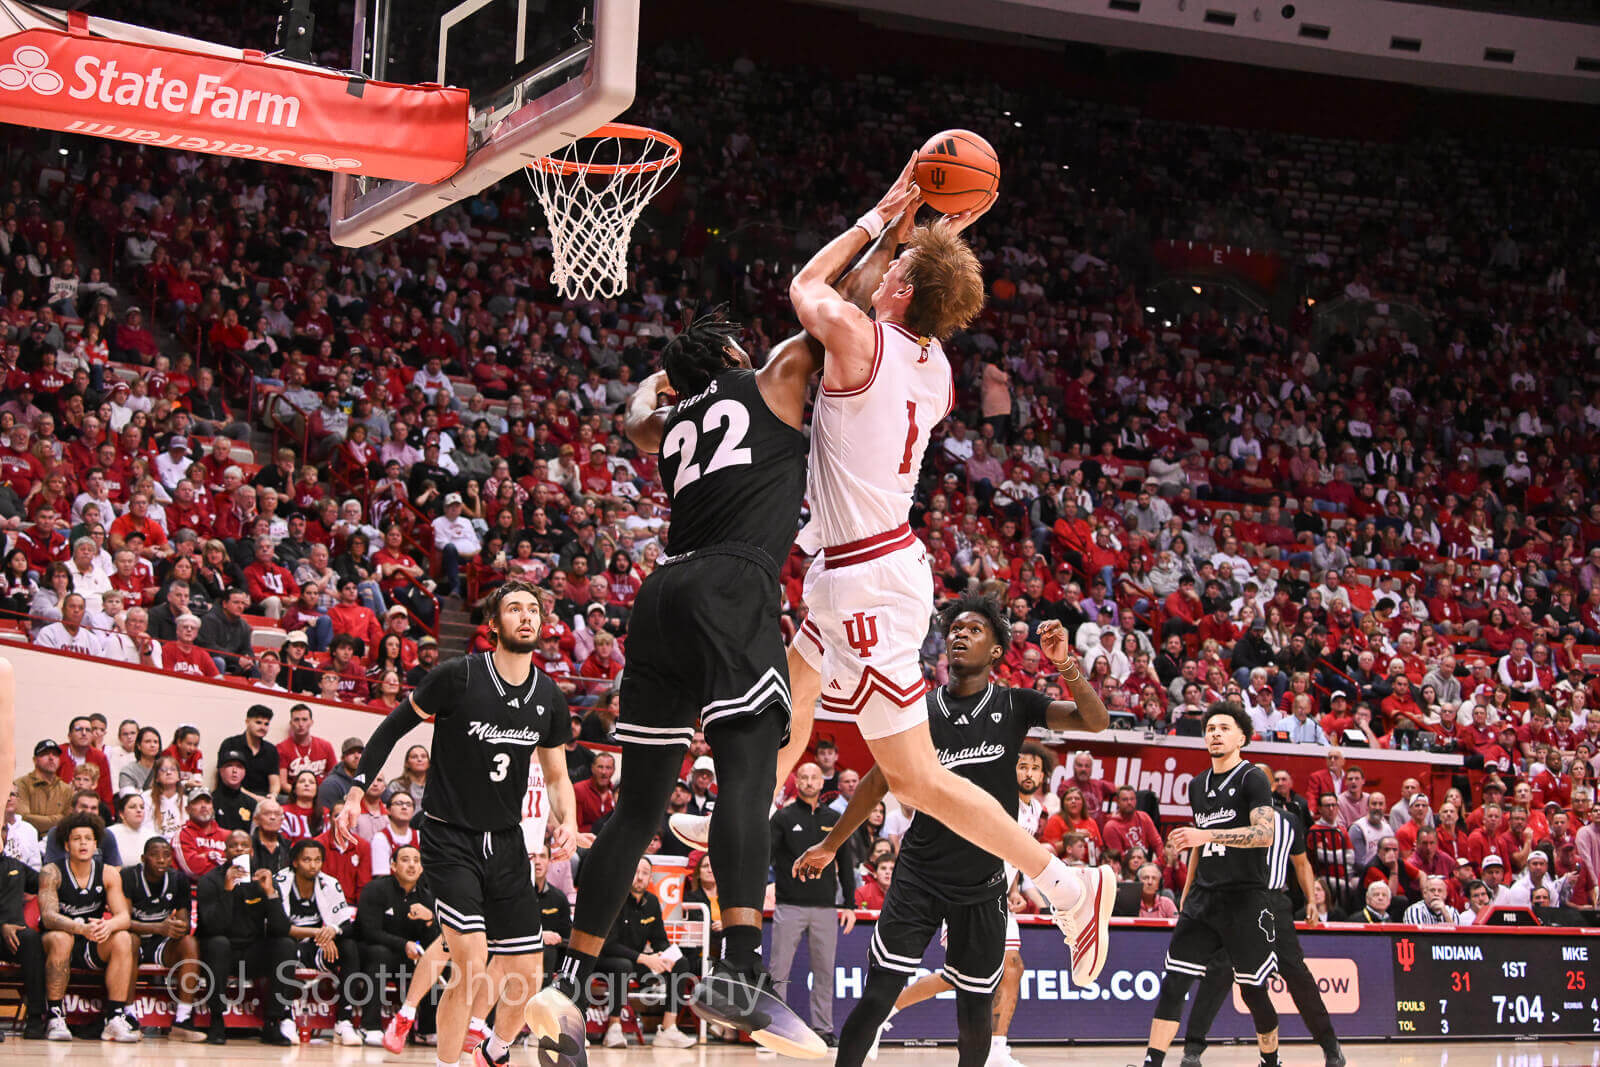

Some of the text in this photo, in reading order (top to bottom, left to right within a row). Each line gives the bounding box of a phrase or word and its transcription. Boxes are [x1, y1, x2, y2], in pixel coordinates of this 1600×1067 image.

[663, 399, 752, 499] 22
[898, 401, 918, 474] 1
[467, 721, 540, 745] Milwaukee
[937, 741, 1005, 769] ilwaukee
[490, 753, 510, 782] 3
[1113, 757, 1194, 805] Unio
[1431, 946, 1589, 961] INDIANA MKE
[1502, 962, 1527, 978] 1ST
[1317, 978, 1350, 993] OW
[1451, 971, 1586, 993] 31 25
[1397, 999, 1448, 1014] FOULS 7
[1491, 995, 1544, 1024] 7:04
[1591, 998, 1599, 1012] 4
[1398, 1019, 1449, 1034] TOL 3
